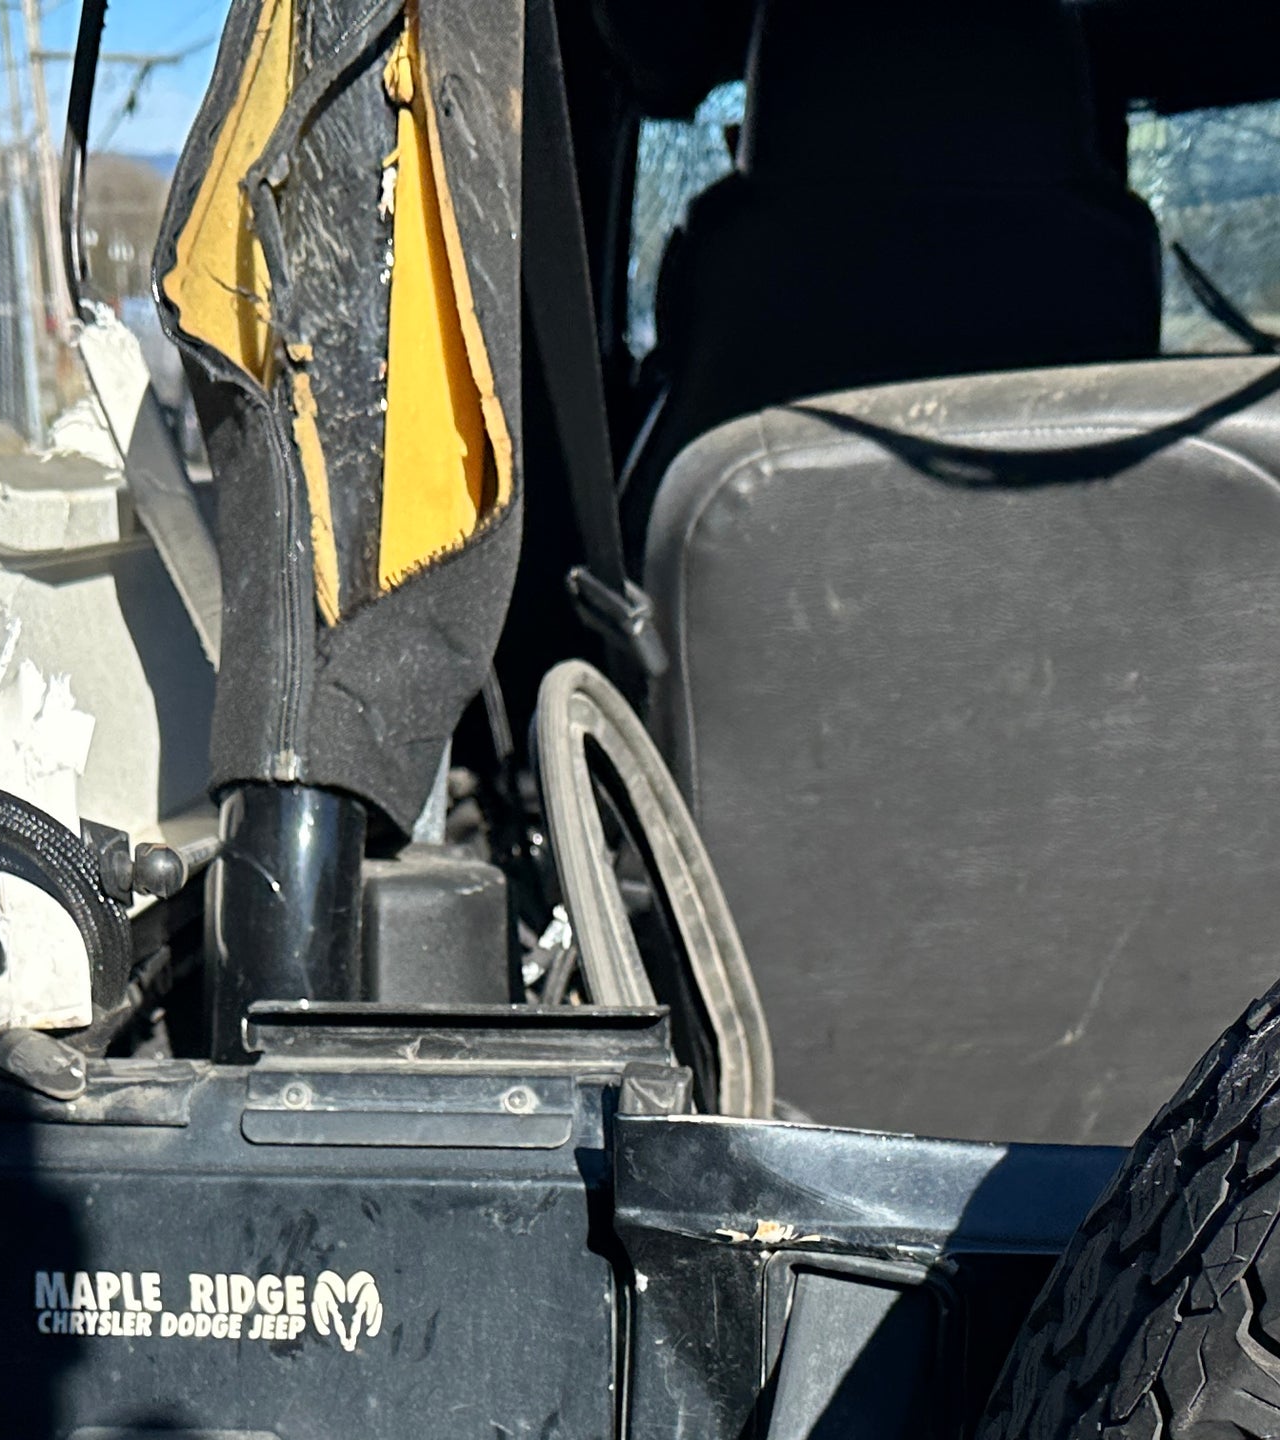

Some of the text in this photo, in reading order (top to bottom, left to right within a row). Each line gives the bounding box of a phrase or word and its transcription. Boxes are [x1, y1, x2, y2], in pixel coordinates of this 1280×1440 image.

[34, 1270, 307, 1316] MAPLE RIDGE
[37, 1310, 307, 1341] CHRYSLER DODGE JEEP
